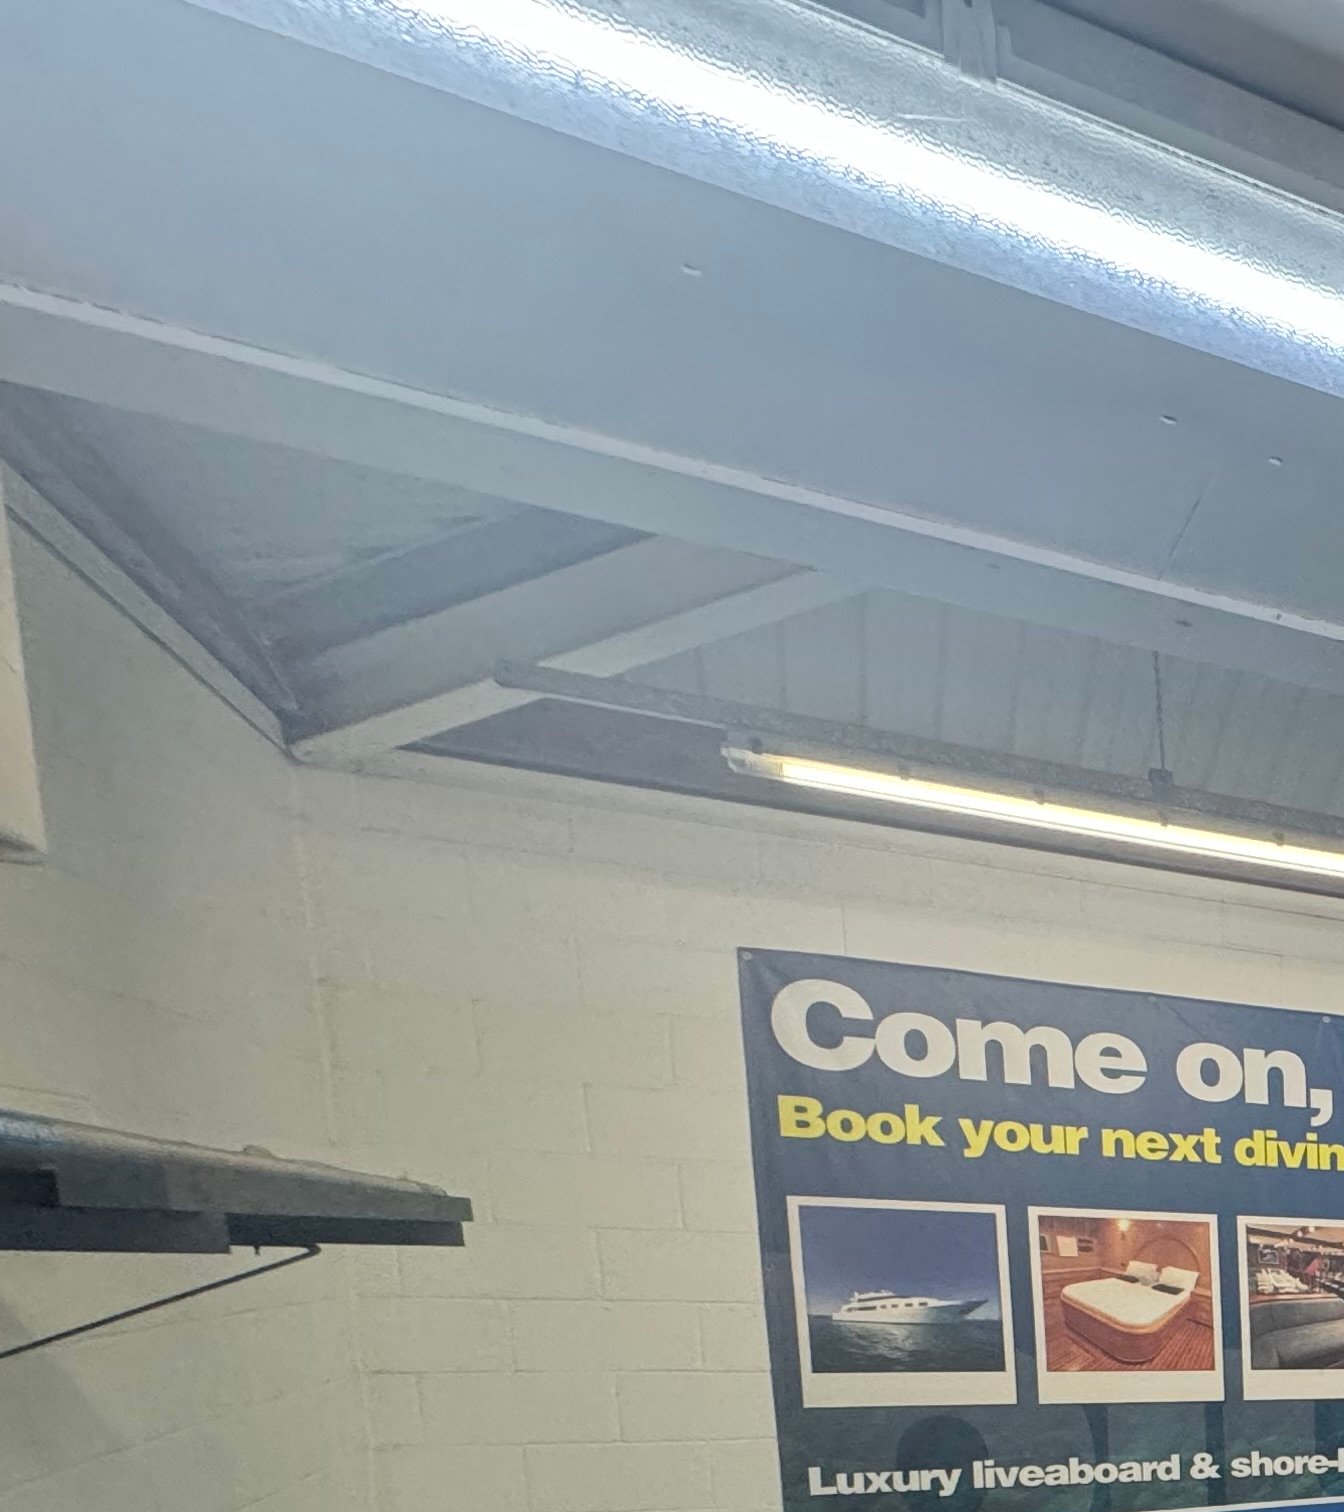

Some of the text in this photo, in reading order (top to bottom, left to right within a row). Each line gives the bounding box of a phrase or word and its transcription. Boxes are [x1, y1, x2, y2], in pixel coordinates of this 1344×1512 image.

[771, 979, 1147, 1094] Come
[1176, 1042, 1333, 1126] on,
[777, 1095, 945, 1146] Book
[957, 1117, 1088, 1158] your
[1102, 1127, 1221, 1164] next
[808, 1467, 962, 1497] Luxury
[973, 1454, 1180, 1489] liveaboard
[1190, 1453, 1218, 1478] &
